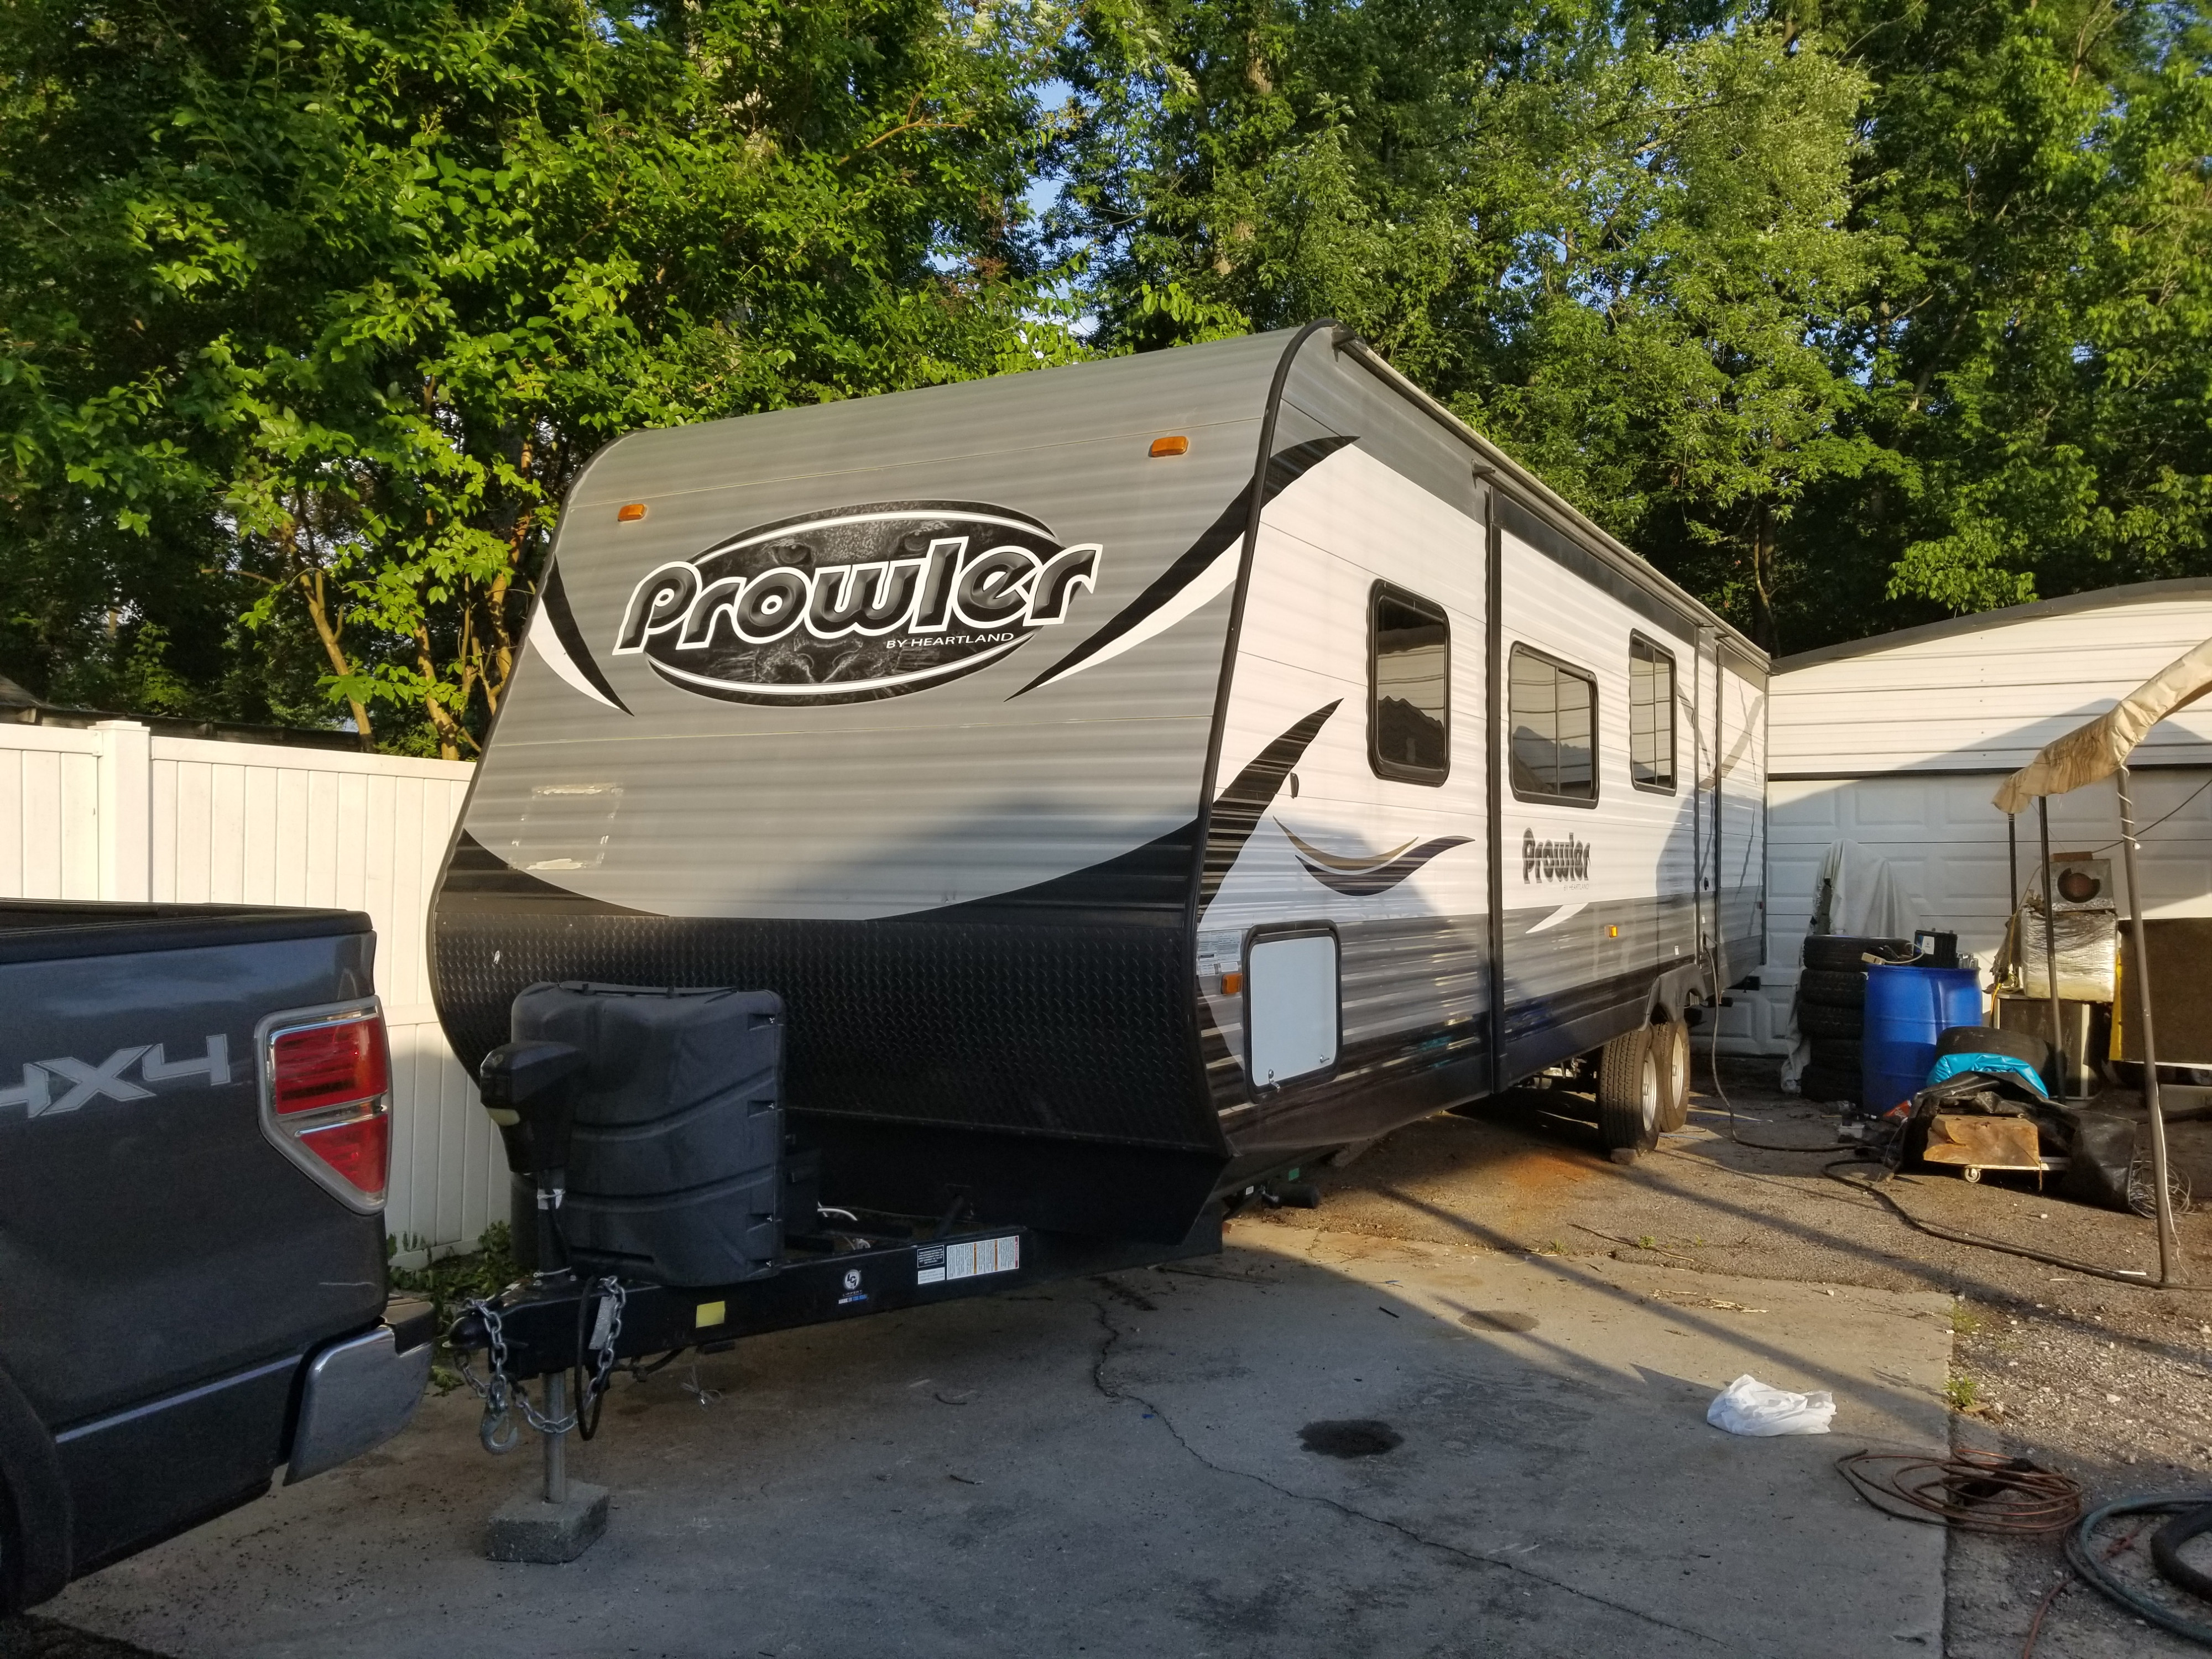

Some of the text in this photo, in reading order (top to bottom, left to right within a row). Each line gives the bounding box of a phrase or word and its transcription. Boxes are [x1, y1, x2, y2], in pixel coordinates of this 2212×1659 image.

[612, 537, 1103, 655] Prowler
[886, 633, 1014, 649] BY HEARTLAND
[1522, 827, 1591, 884] Prowler
